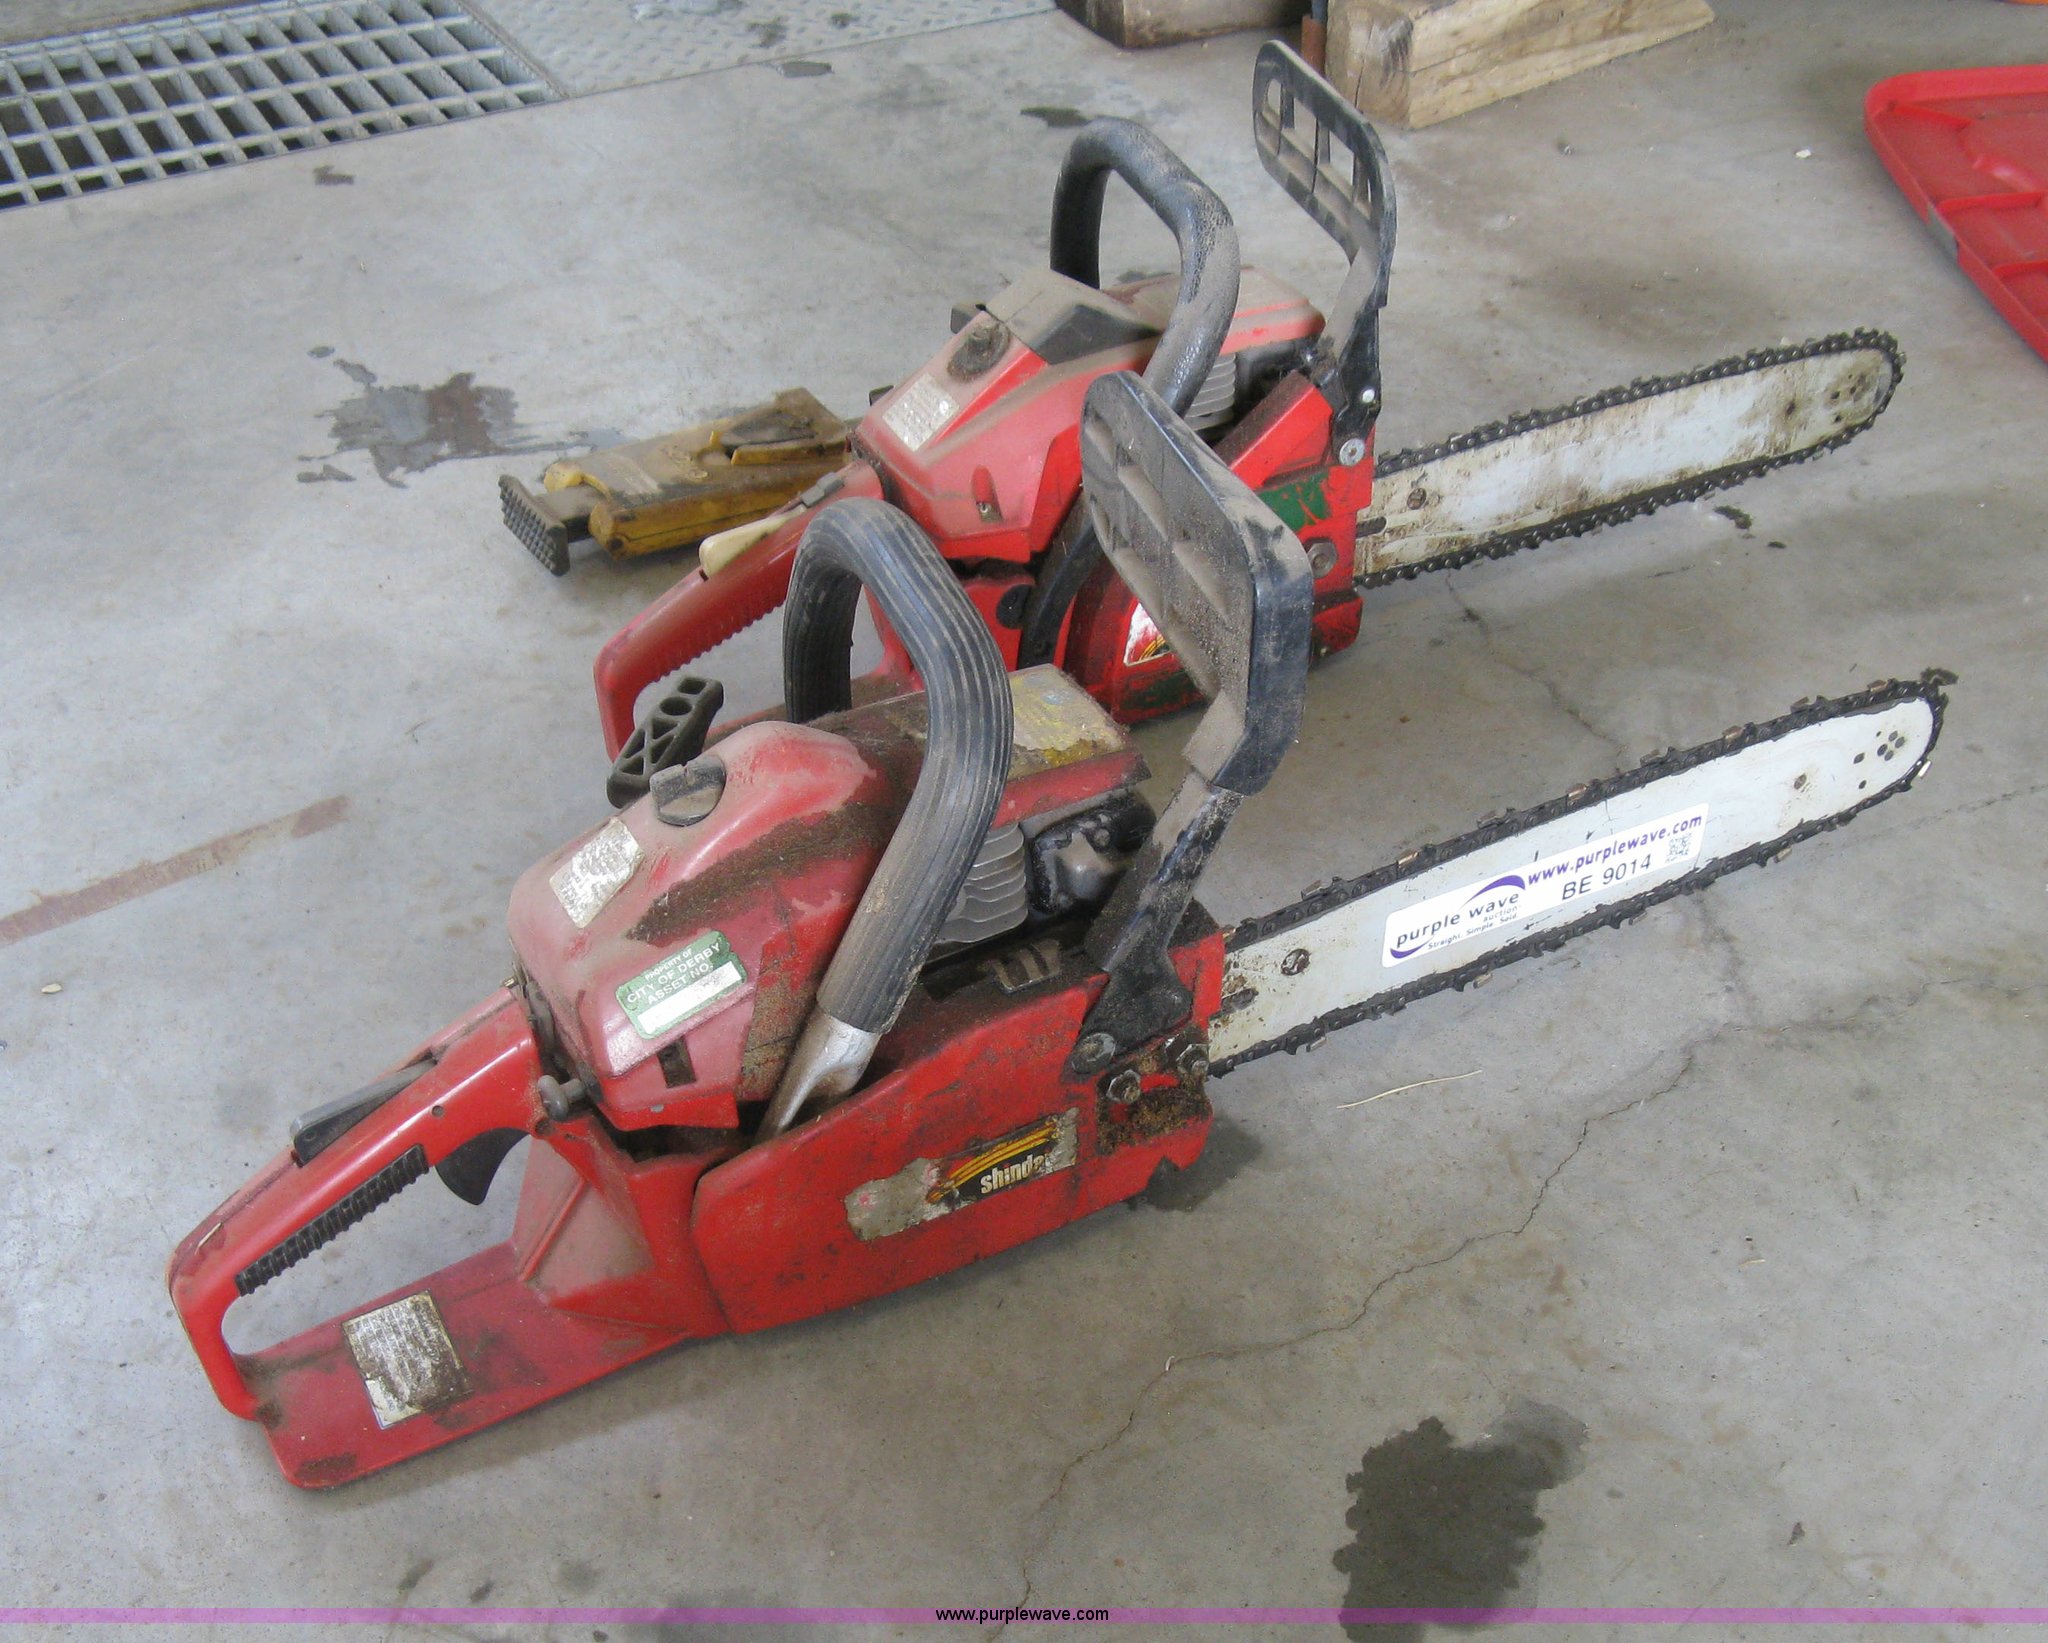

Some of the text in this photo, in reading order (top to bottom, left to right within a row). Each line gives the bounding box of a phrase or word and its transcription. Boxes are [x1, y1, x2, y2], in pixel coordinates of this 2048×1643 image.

[1528, 815, 1703, 886] www.purplewave.com
[1562, 853, 1652, 901] BE 9014
[1396, 893, 1519, 948] purple wave
[627, 942, 721, 1003] CITY OF DERBY
[645, 955, 681, 981] PROPERTY
[647, 963, 714, 1004] ASSET NO.
